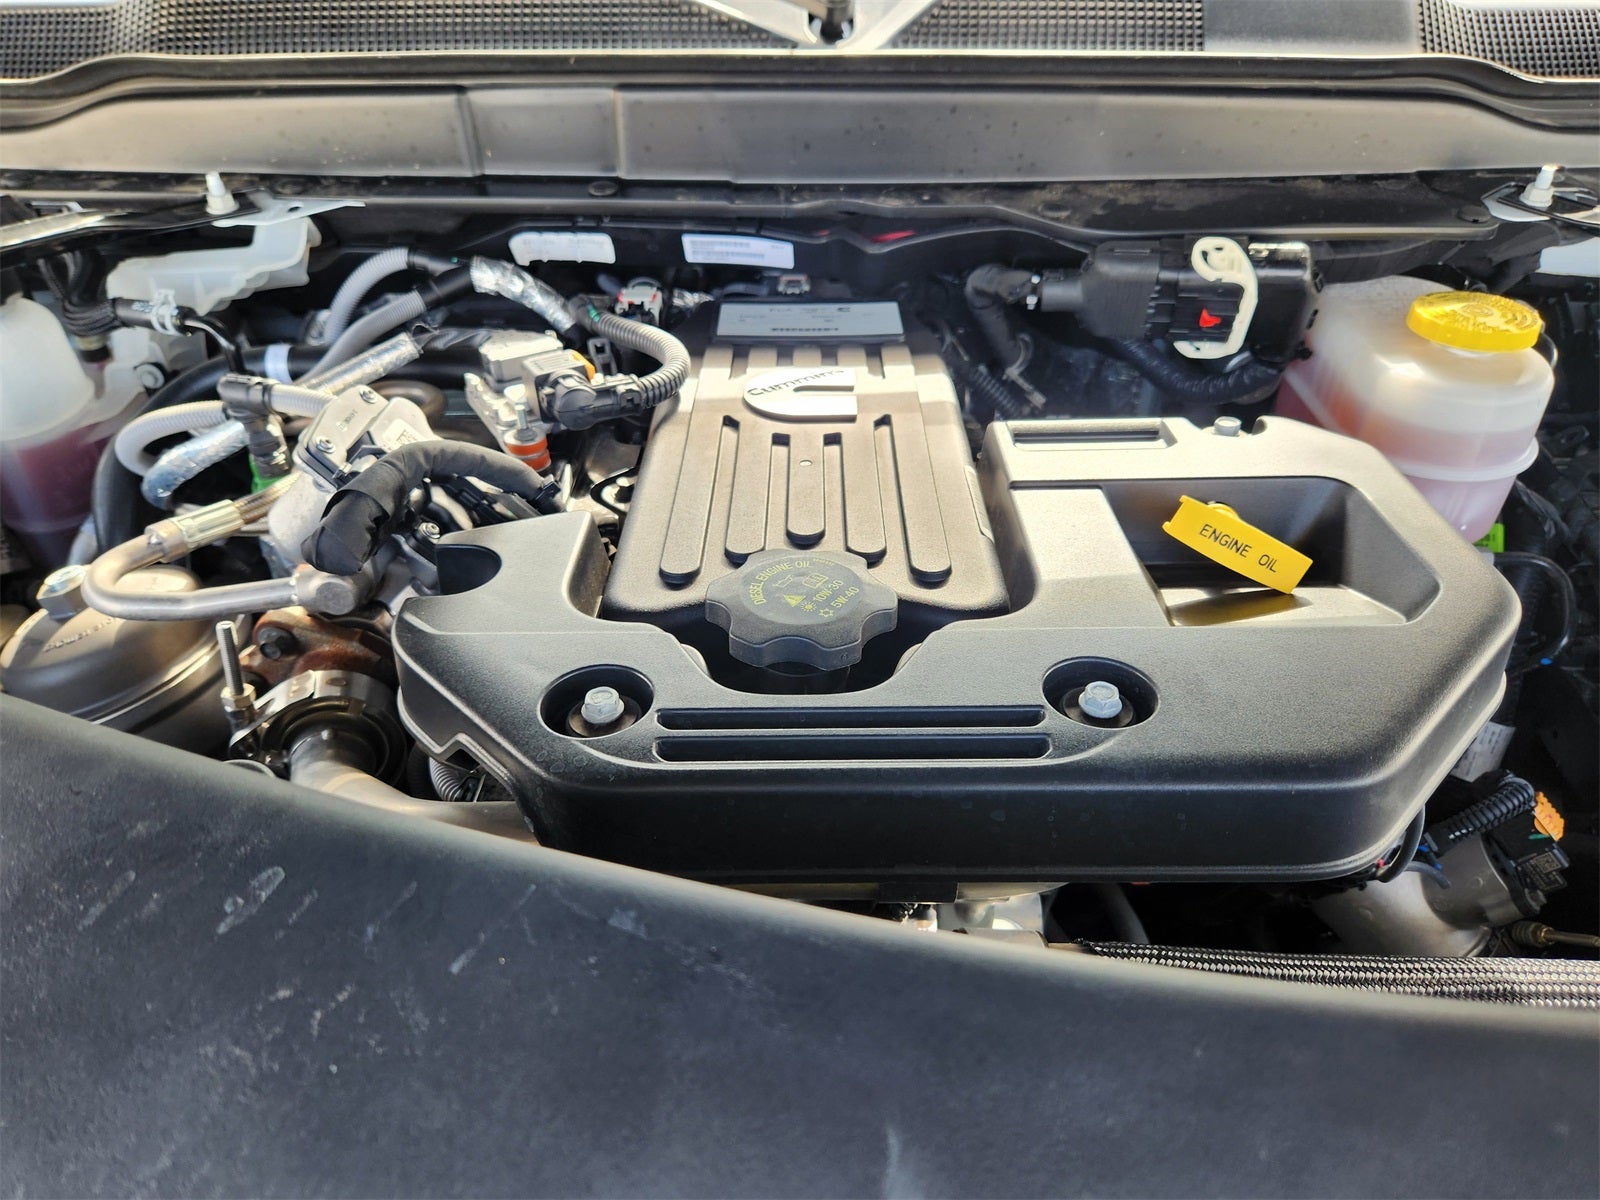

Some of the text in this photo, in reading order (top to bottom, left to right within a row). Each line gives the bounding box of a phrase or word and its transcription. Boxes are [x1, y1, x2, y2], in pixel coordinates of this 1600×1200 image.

[1199, 523, 1279, 573] ENGINE OIL
[755, 562, 793, 581] ENGINE
[795, 560, 811, 568] OIL
[749, 582, 767, 605] DIESEL
[813, 580, 844, 602] 10W-30
[830, 587, 860, 608] 5W-40
